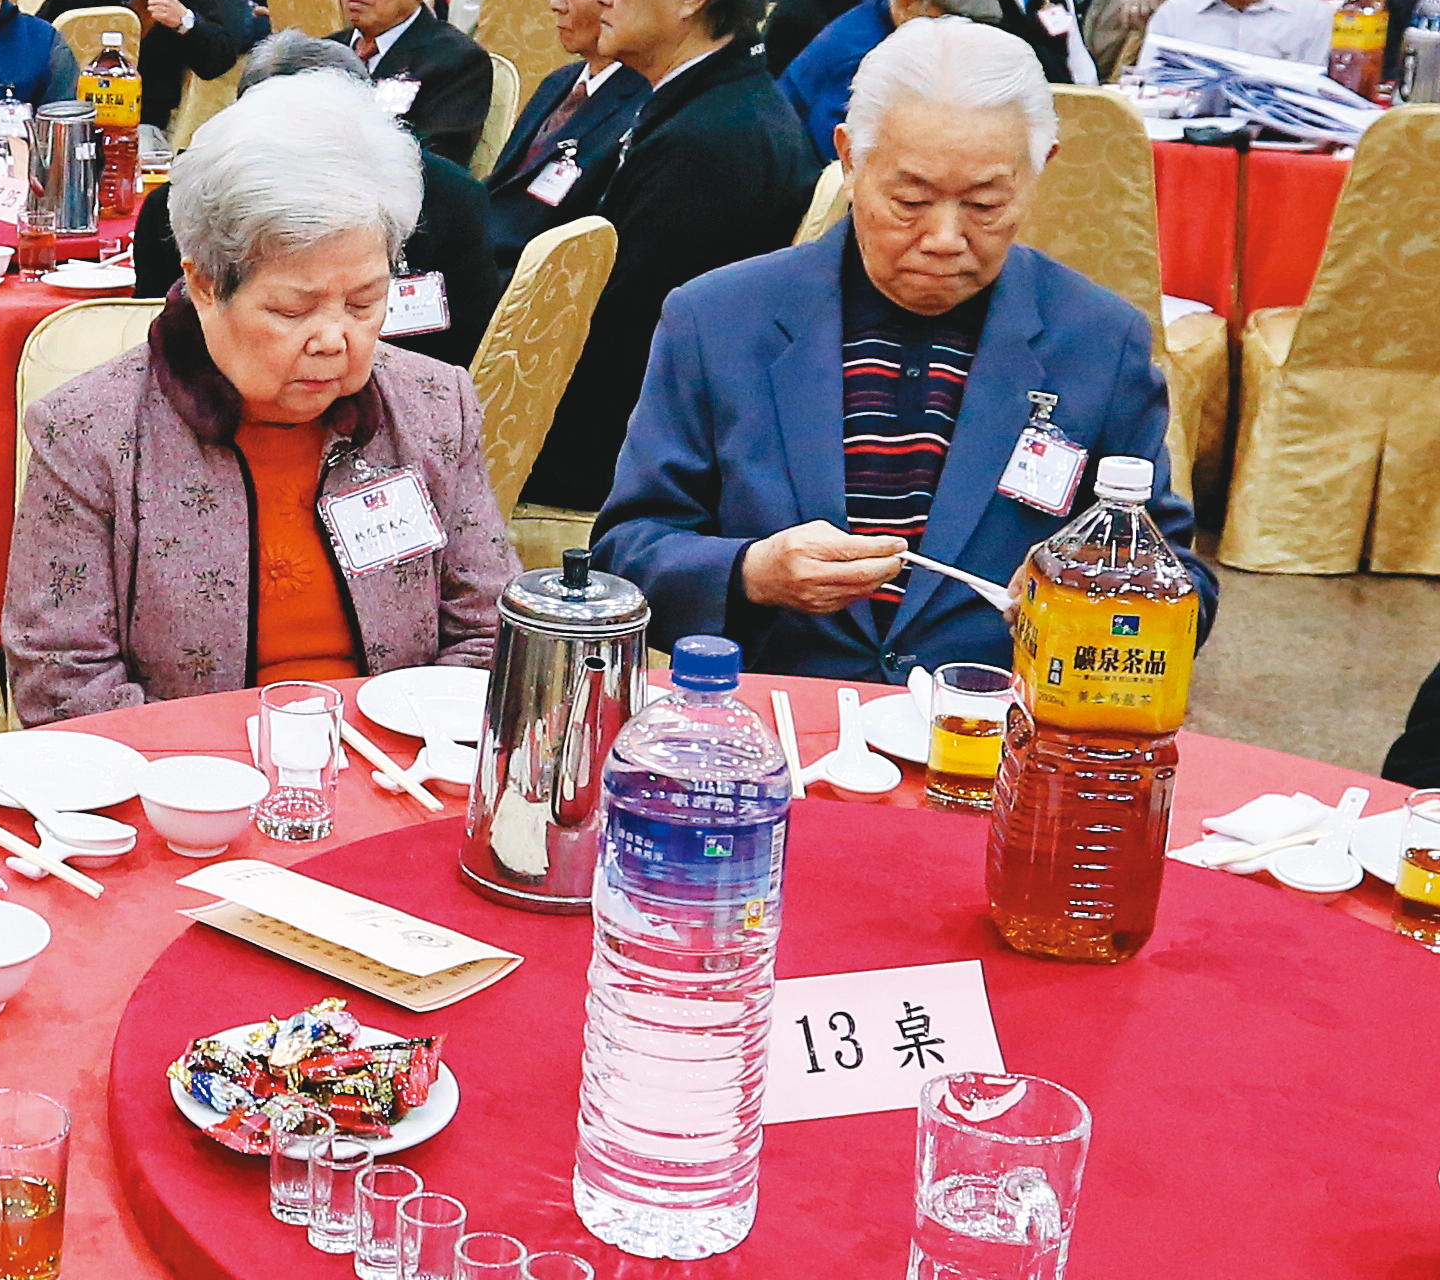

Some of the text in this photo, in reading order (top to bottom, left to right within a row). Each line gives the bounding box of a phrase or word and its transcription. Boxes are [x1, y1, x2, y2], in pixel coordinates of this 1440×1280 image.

[1073, 645, 1167, 675] 礦泉茶品
[795, 1001, 946, 1074] 13 桌
